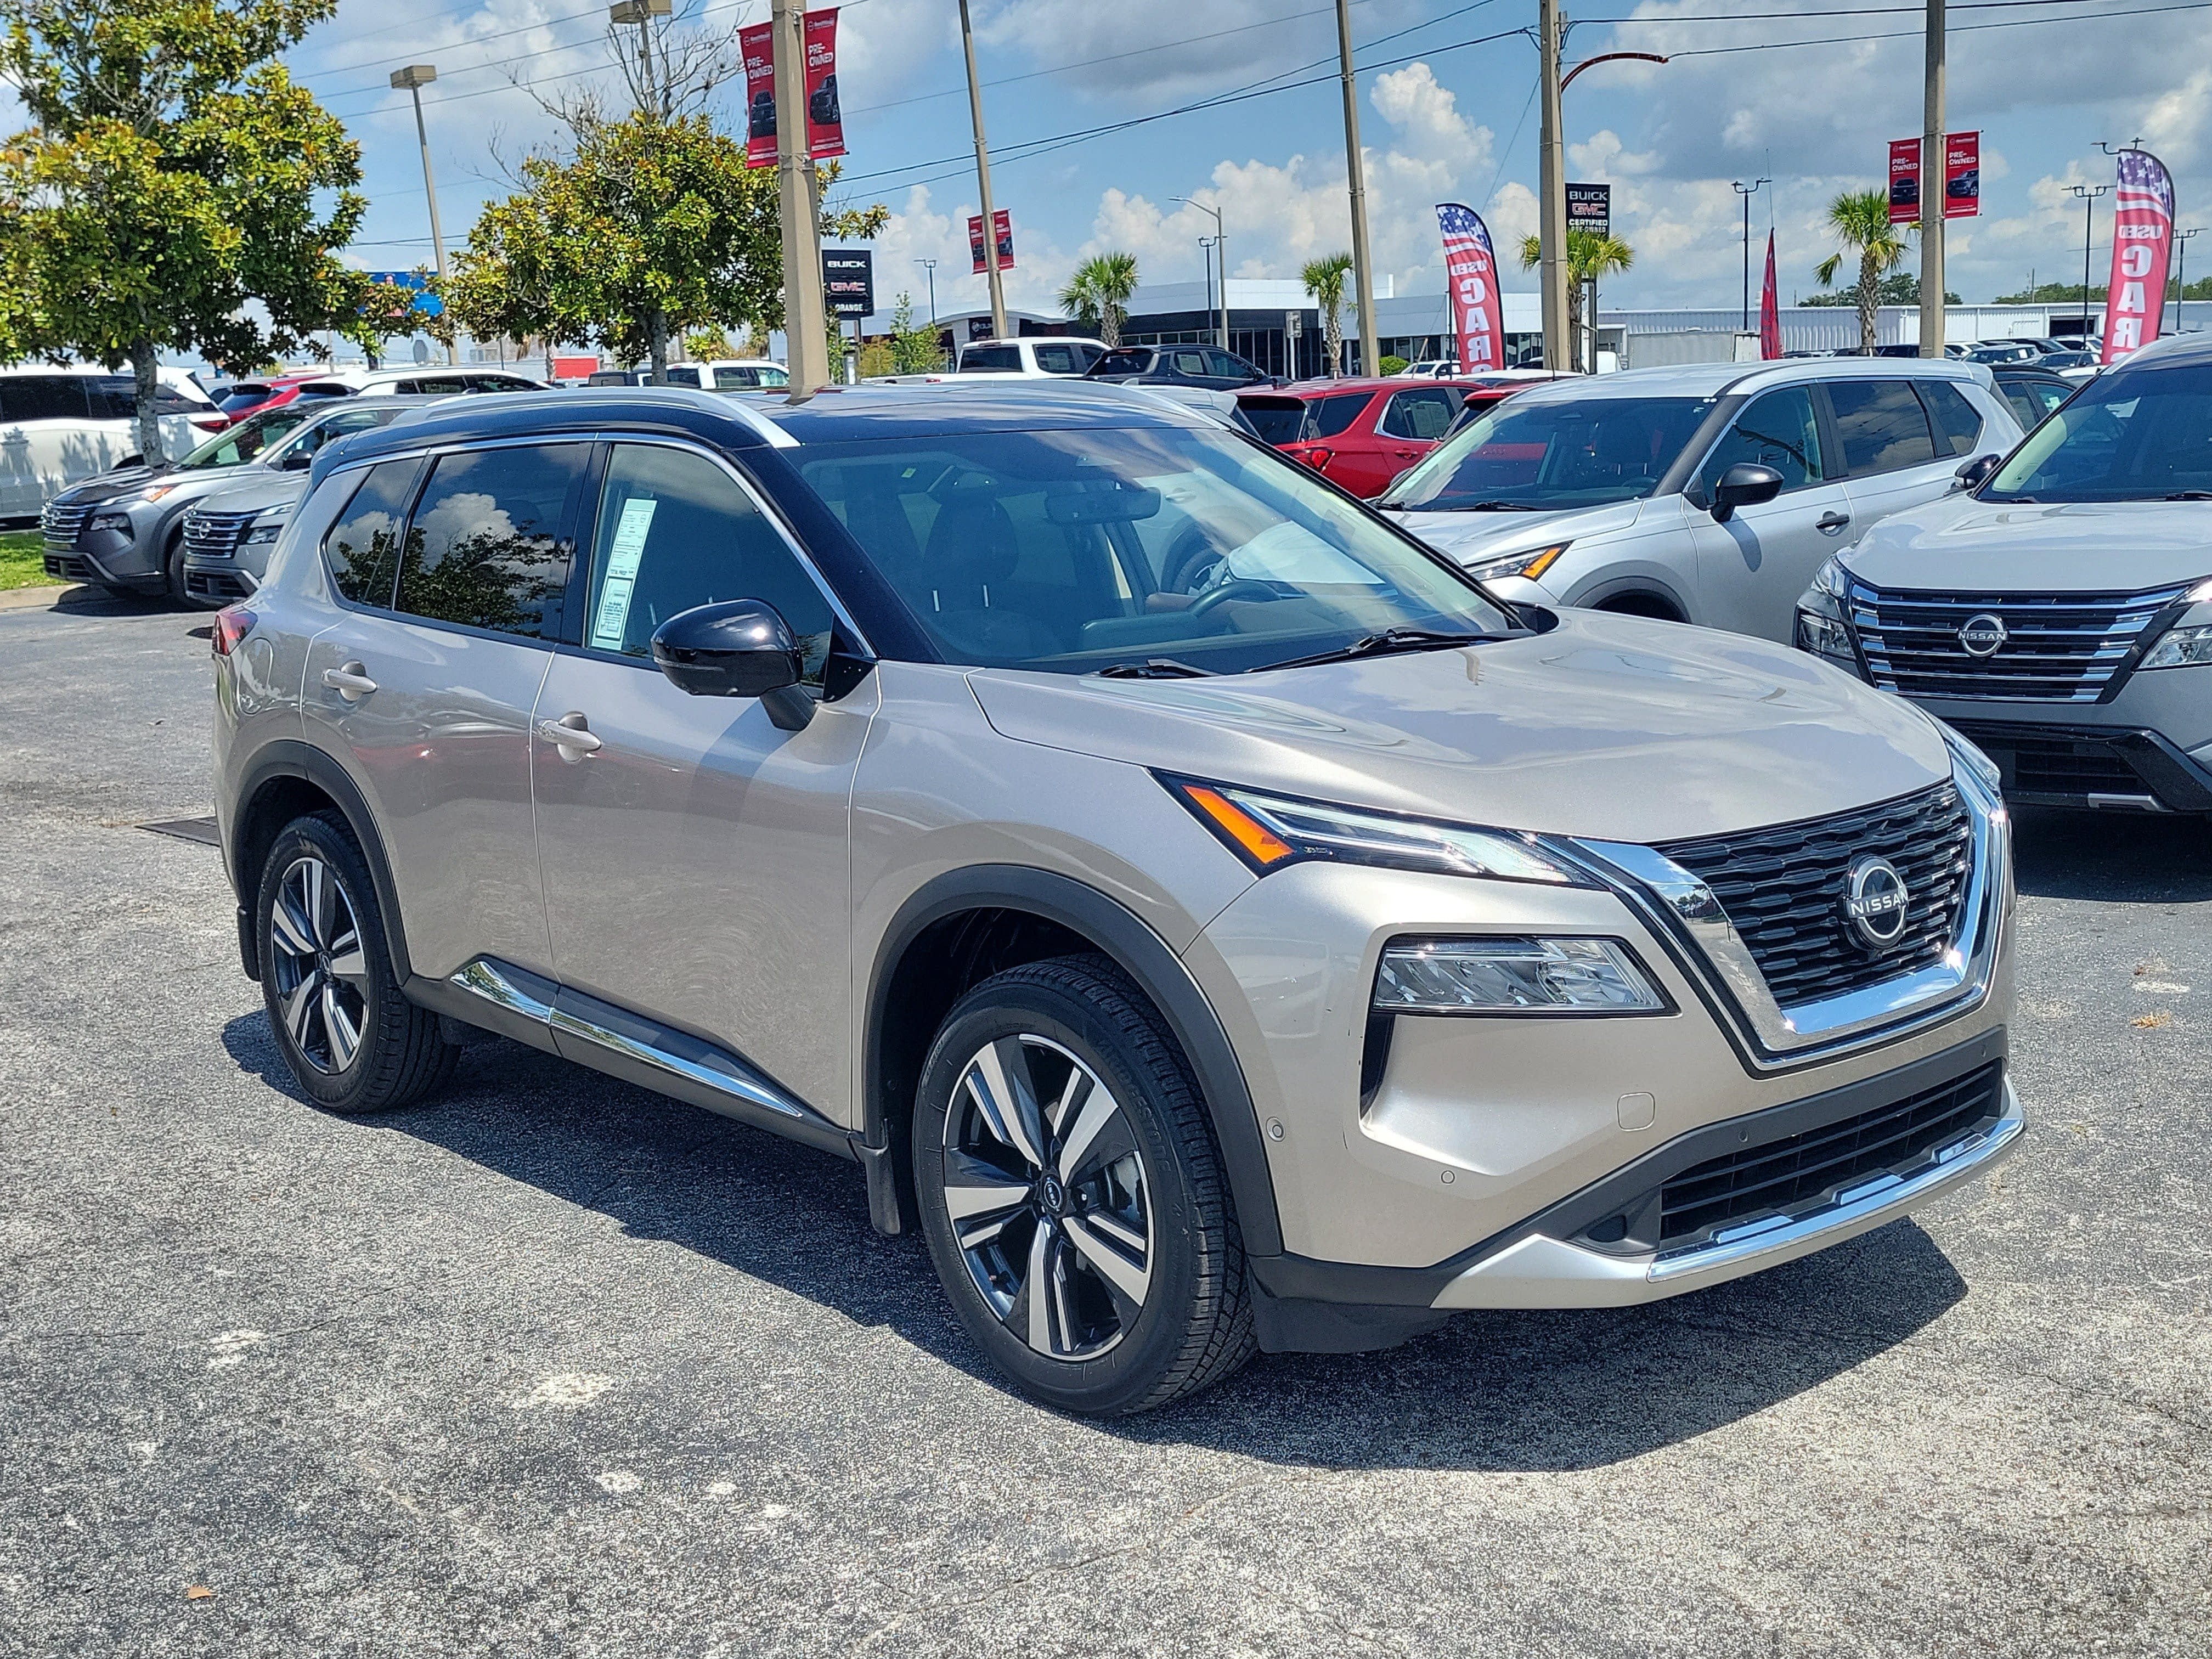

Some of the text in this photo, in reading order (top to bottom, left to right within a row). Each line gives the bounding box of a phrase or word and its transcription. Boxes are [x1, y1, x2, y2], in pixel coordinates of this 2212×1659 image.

[808, 43, 826, 55] PRE-
[747, 57, 764, 69] PRE-
[809, 52, 833, 67] OWNED
[748, 65, 773, 79] OWNED
[1892, 163, 1918, 171] OWNED
[1949, 157, 1976, 165] OWNED
[1569, 191, 1607, 201] BUICK
[1572, 203, 1606, 216] GMC
[831, 281, 866, 291] GMC
[1958, 632, 2006, 640] NISSAN
[1850, 890, 1909, 916] NISSAN
